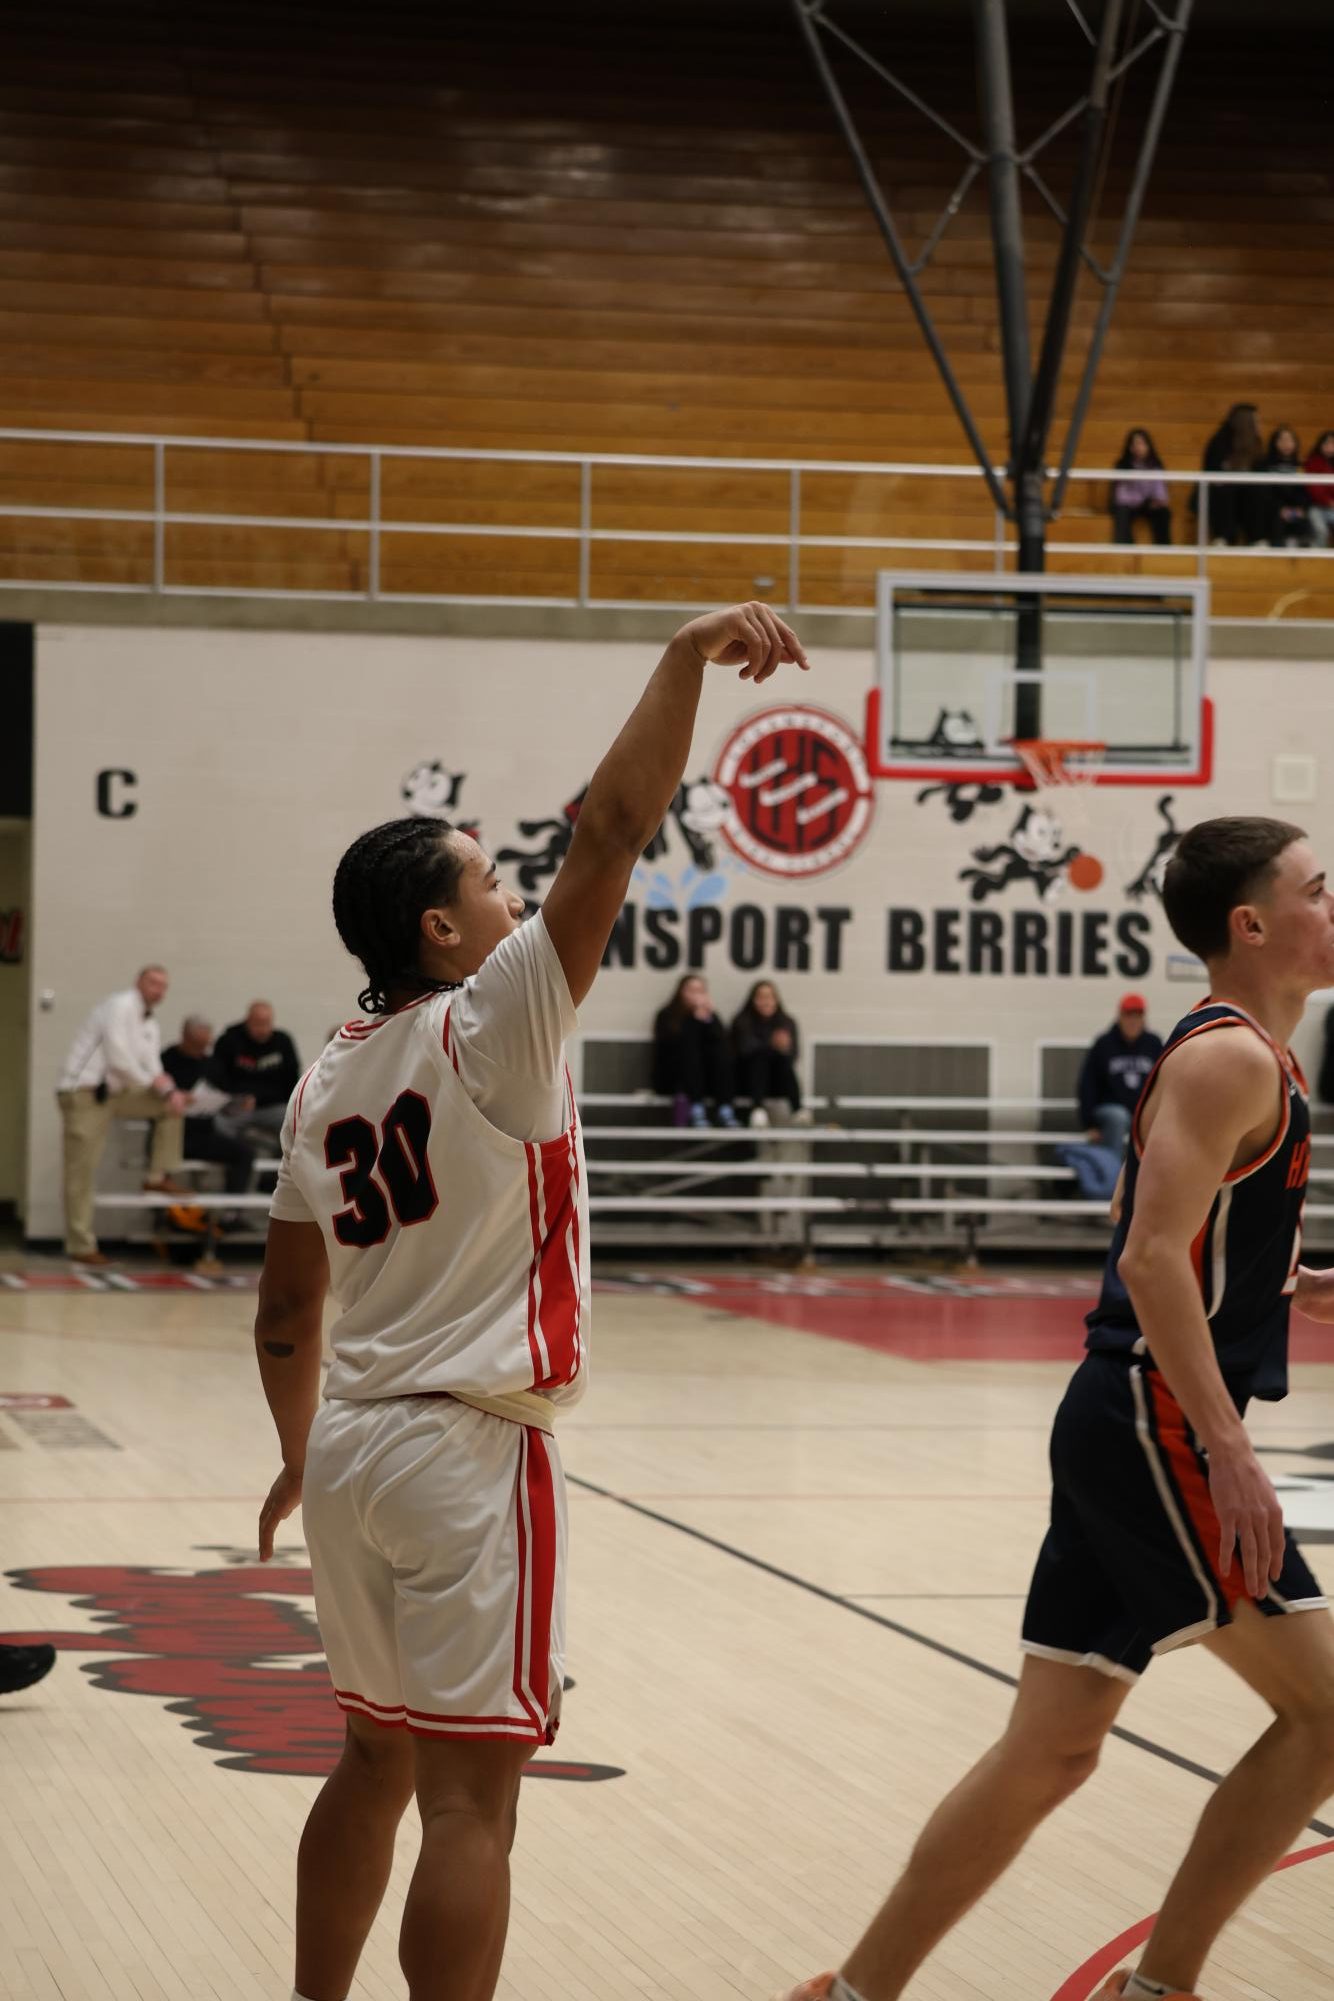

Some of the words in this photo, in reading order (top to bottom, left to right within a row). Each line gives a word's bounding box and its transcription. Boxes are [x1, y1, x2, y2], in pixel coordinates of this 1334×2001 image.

[96, 768, 137, 820] C
[600, 902, 853, 971] NSPORT
[888, 908, 1151, 978] BERRIES
[324, 1088, 440, 1249] 30
